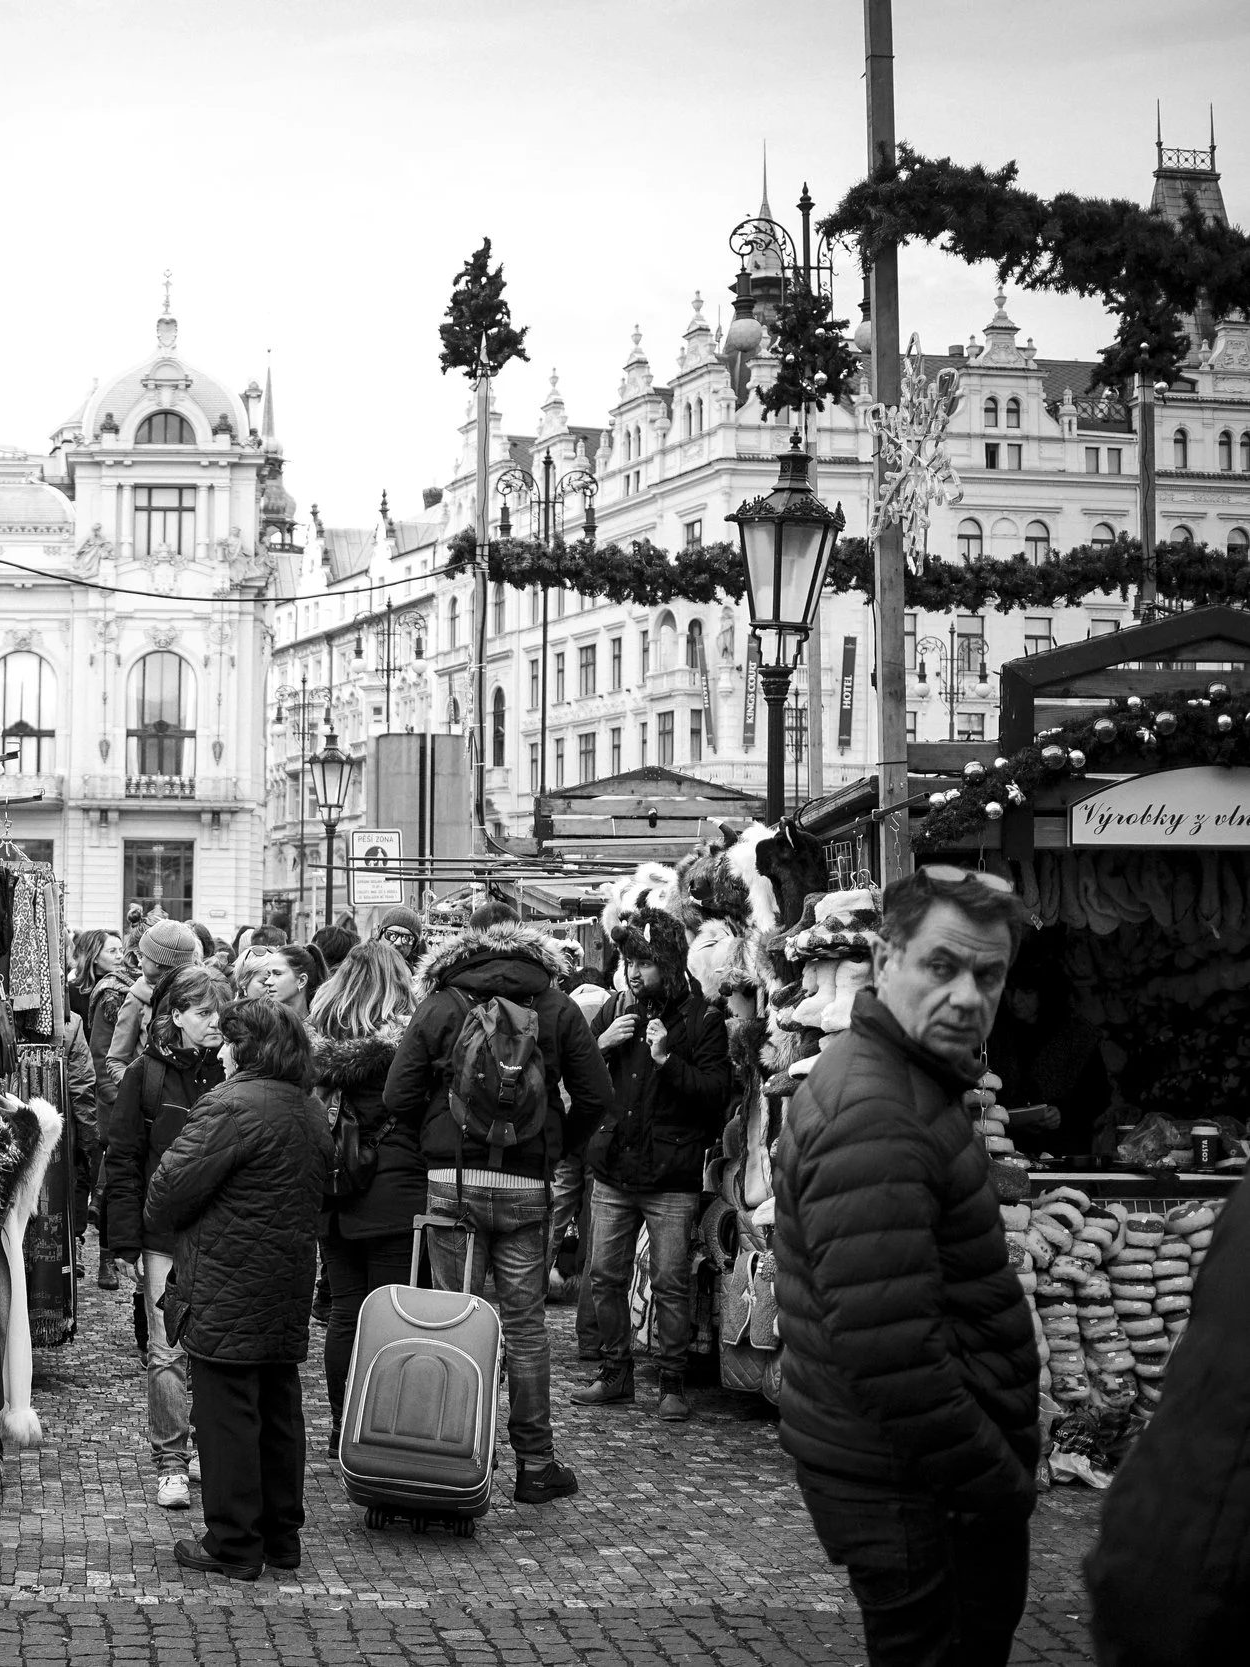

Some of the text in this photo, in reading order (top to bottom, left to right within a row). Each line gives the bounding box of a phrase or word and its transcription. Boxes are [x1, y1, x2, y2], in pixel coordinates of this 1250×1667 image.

[745, 660, 757, 724] KINGS COURT
[842, 674, 853, 709] HOTEL
[1079, 802, 1189, 836] Výrobky
[1189, 813, 1211, 836] z
[375, 835, 394, 843] ZONA
[1201, 1139, 1209, 1162] COSTA
